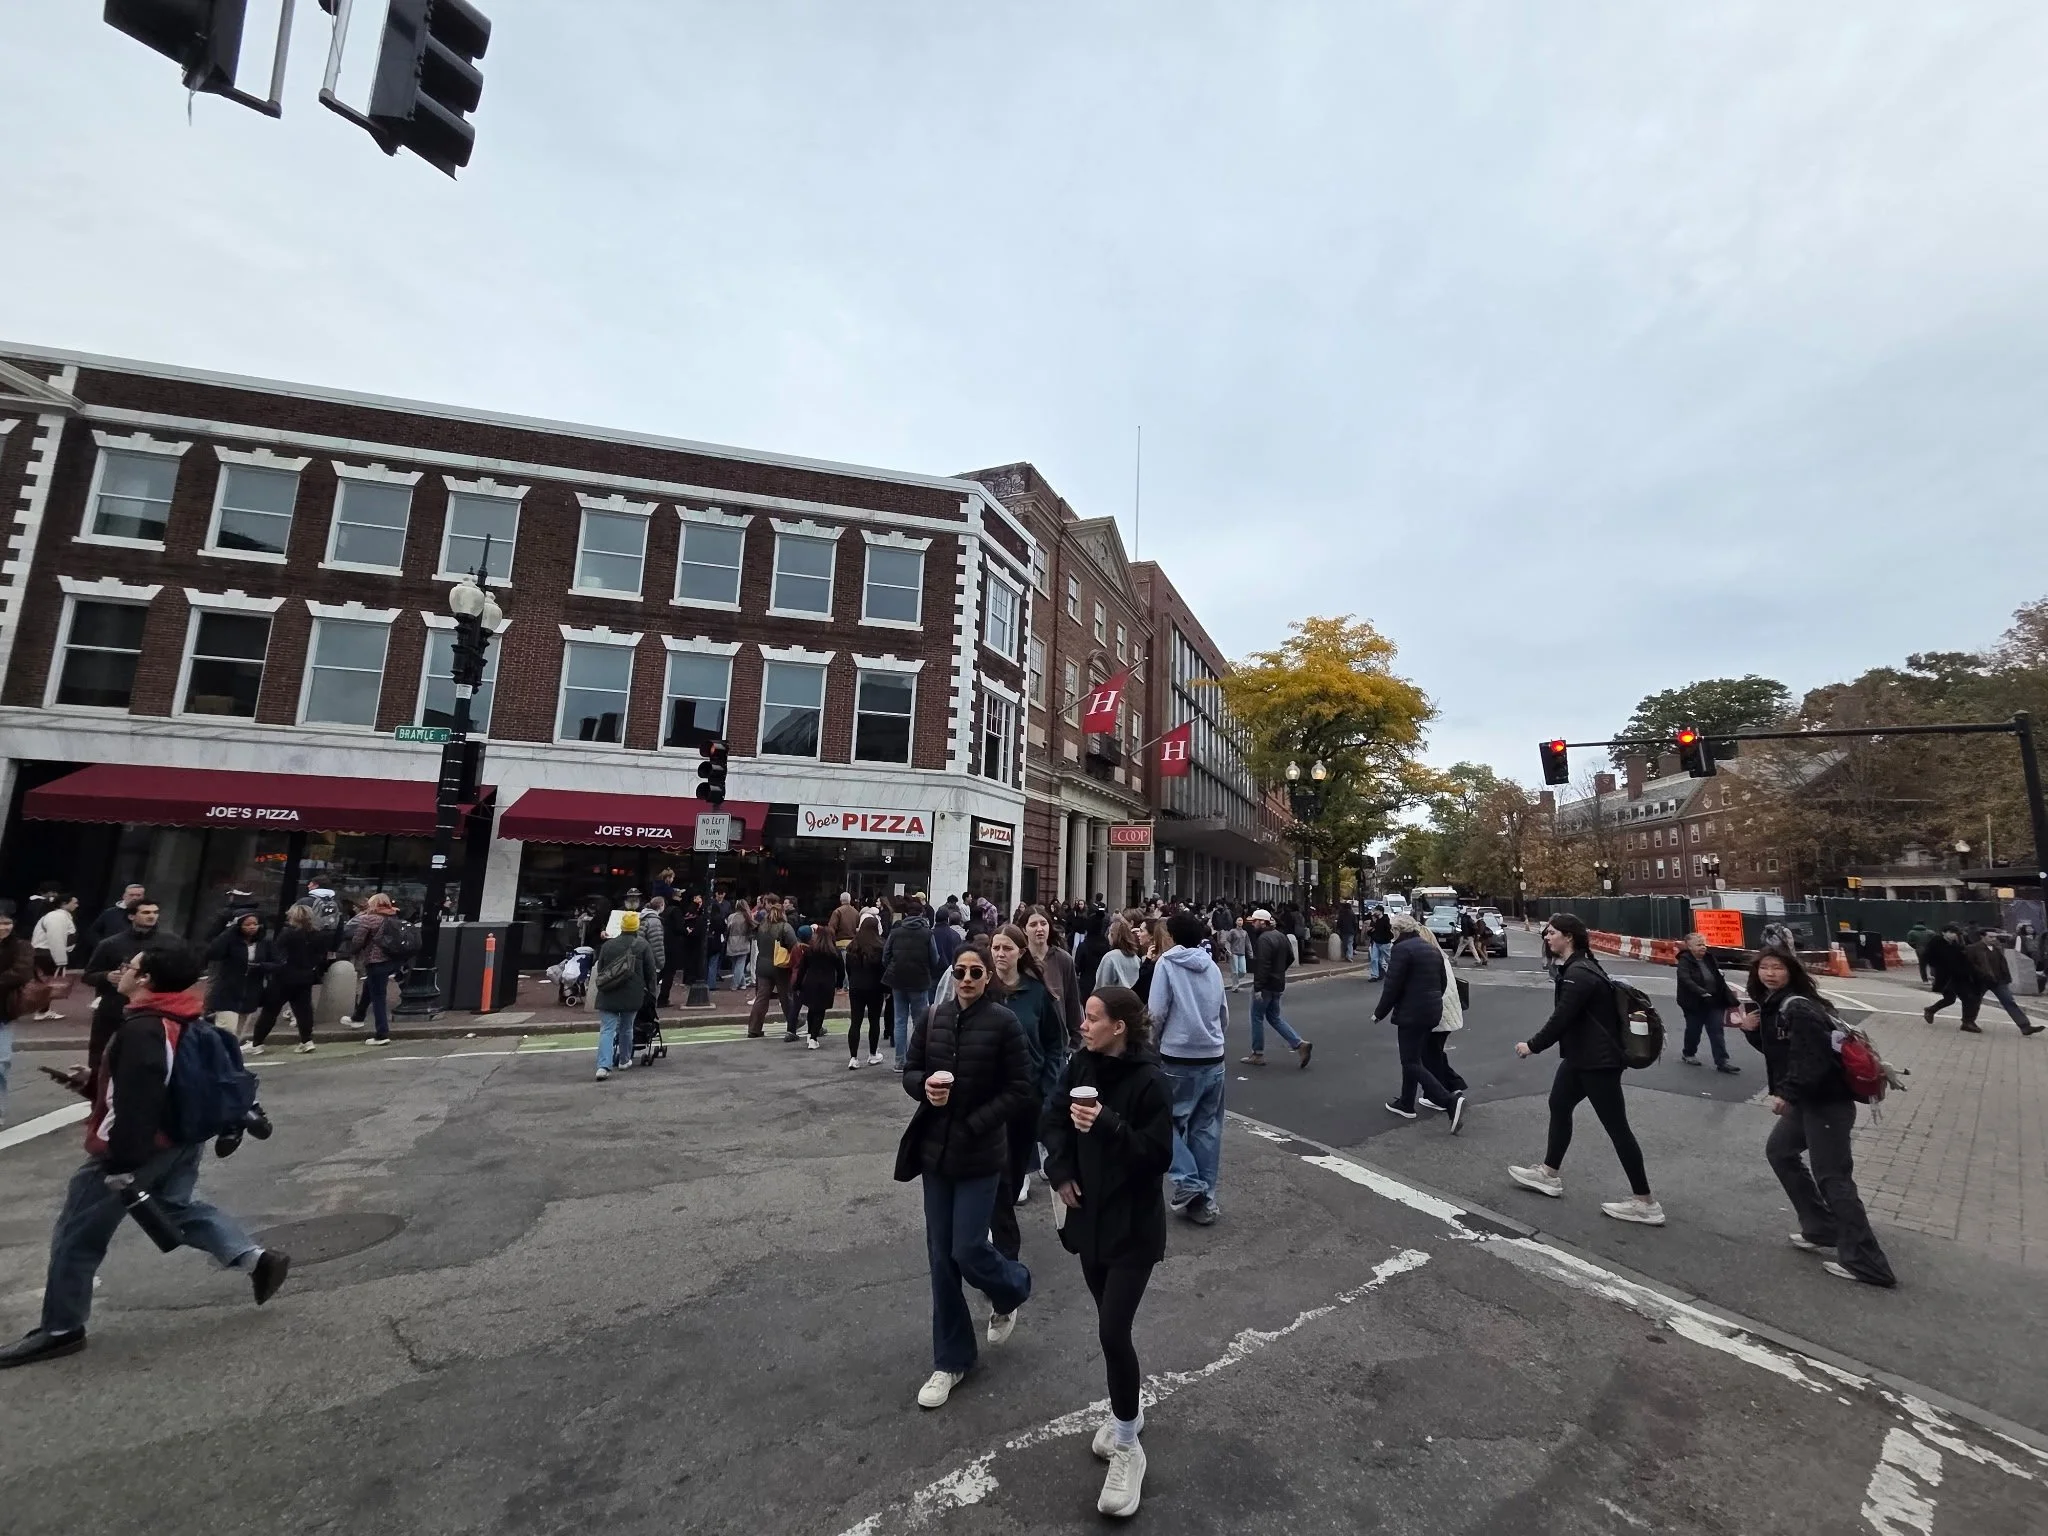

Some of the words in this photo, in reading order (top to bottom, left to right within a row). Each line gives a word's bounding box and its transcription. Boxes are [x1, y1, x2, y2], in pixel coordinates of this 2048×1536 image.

[1085, 690, 1119, 716] H
[399, 728, 435, 740] BRATTLE
[1160, 740, 1187, 761] H
[206, 806, 252, 819] JOE'S
[255, 808, 299, 820] PIZZA
[711, 817, 725, 825] LEFT
[805, 810, 839, 832] Joe's
[842, 812, 925, 834] PIZZA
[594, 825, 633, 836] JOE'S
[636, 827, 673, 838] PIZZA
[705, 828, 720, 836] TURN
[990, 828, 1011, 842] PIZZA
[1117, 830, 1148, 842] COOP
[884, 855, 892, 864] 3
